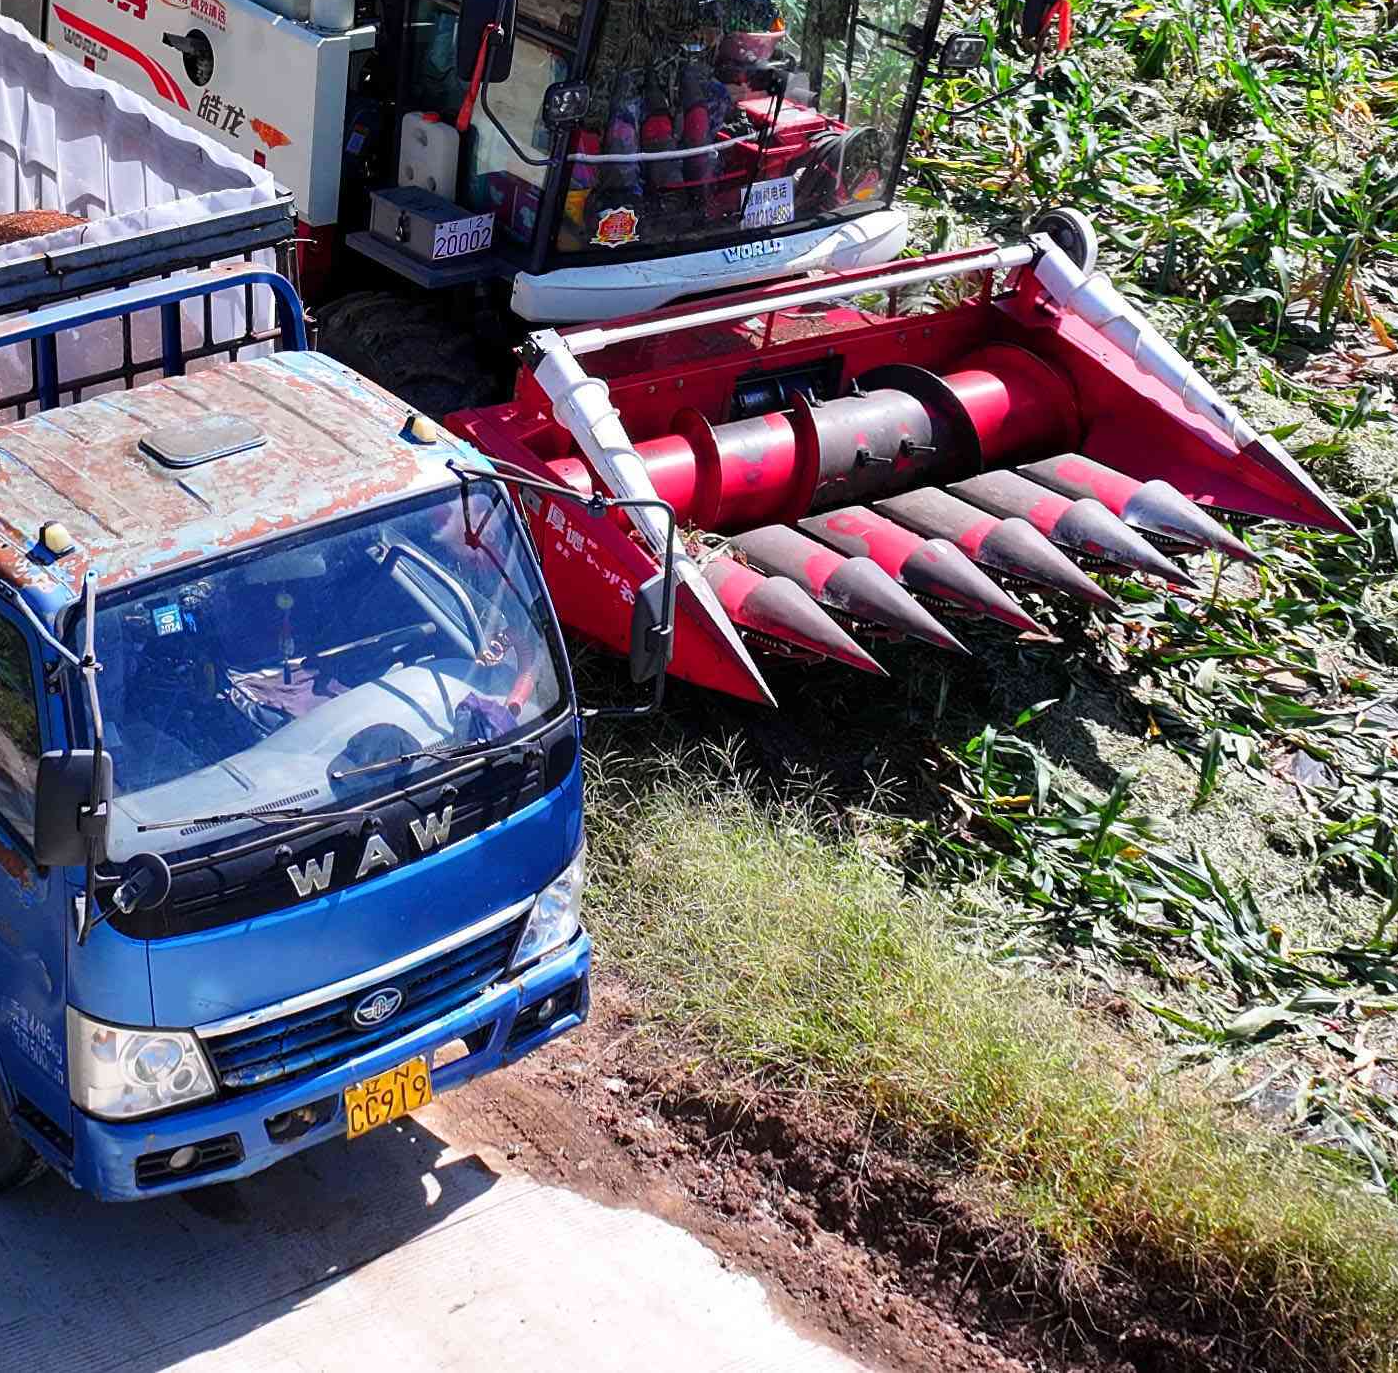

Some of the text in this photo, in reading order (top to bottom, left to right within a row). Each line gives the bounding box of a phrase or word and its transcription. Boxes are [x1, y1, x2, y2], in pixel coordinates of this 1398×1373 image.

[63, 28, 108, 62] WORLD
[434, 227, 491, 258] 20002
[723, 239, 783, 264] WORLD
[287, 805, 453, 898] WAW
[351, 1075, 426, 1133] CC919
